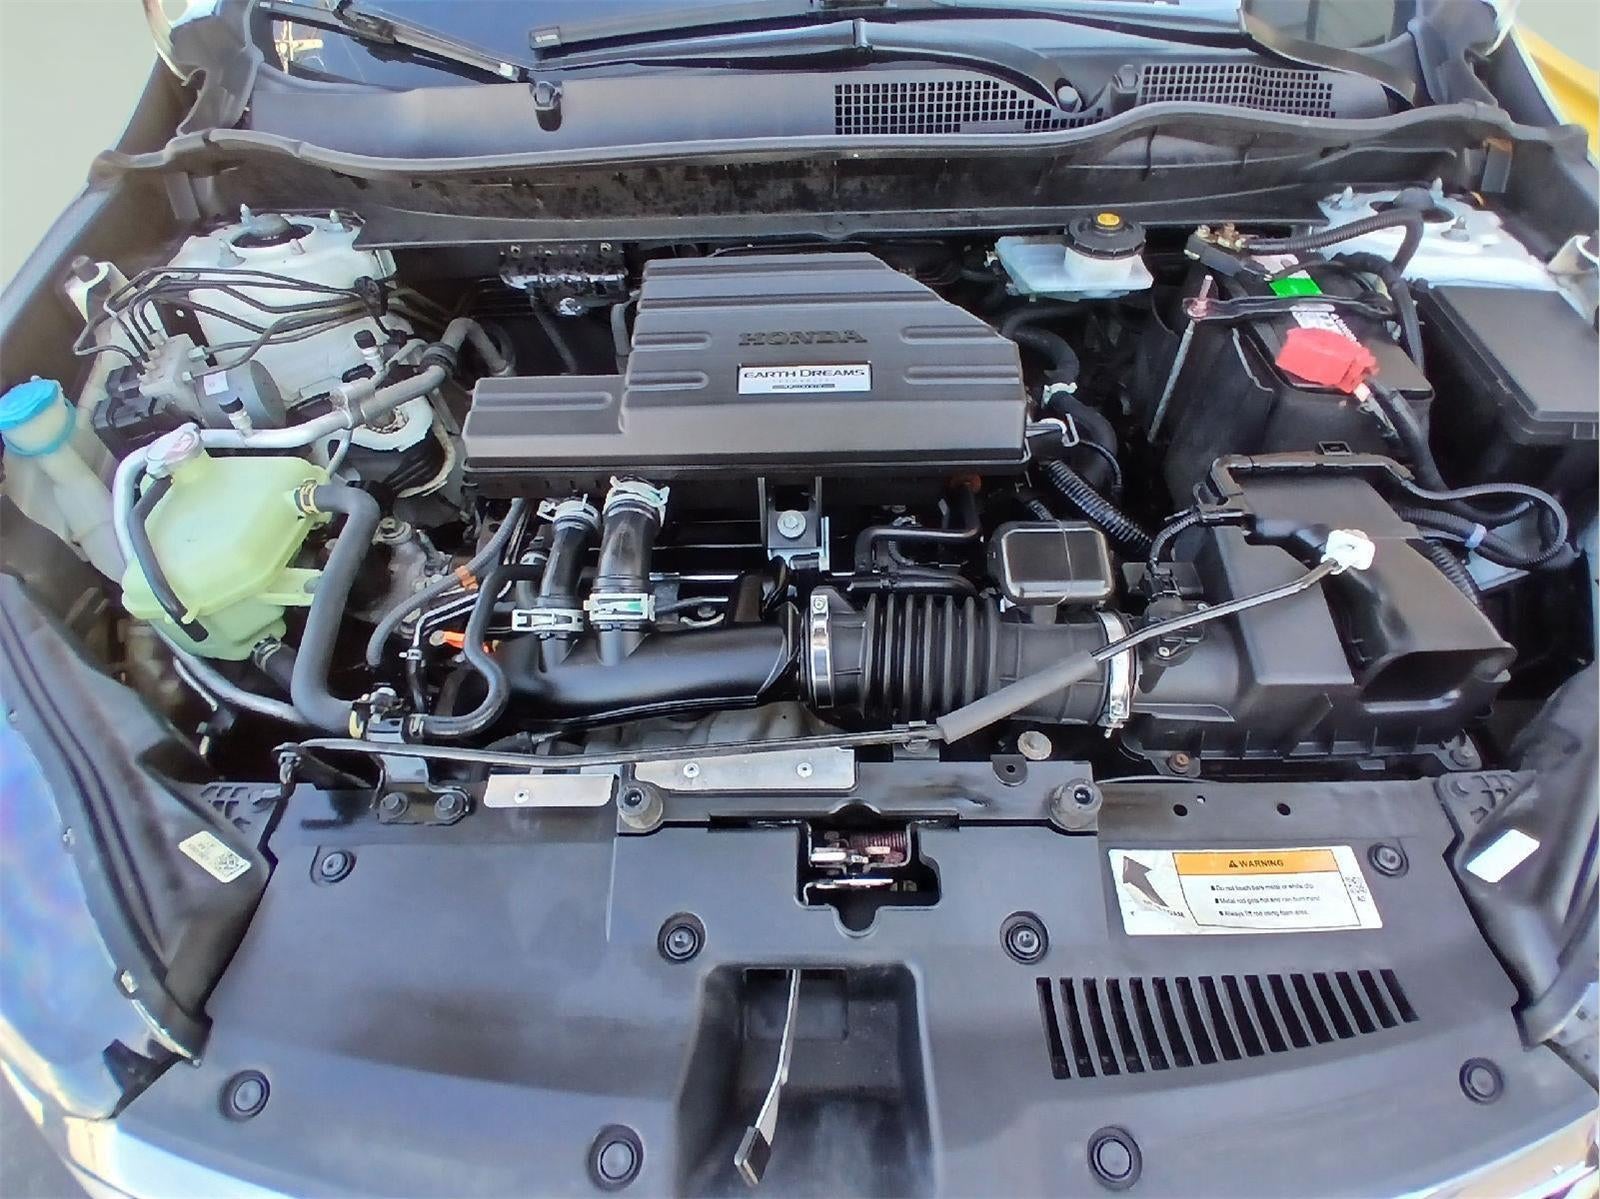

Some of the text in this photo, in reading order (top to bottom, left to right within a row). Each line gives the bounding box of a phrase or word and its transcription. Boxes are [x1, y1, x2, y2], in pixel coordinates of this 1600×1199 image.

[738, 329, 868, 346] HONDA
[744, 368, 866, 379] EARTH DREAMS
[1238, 859, 1285, 868] WARNING
